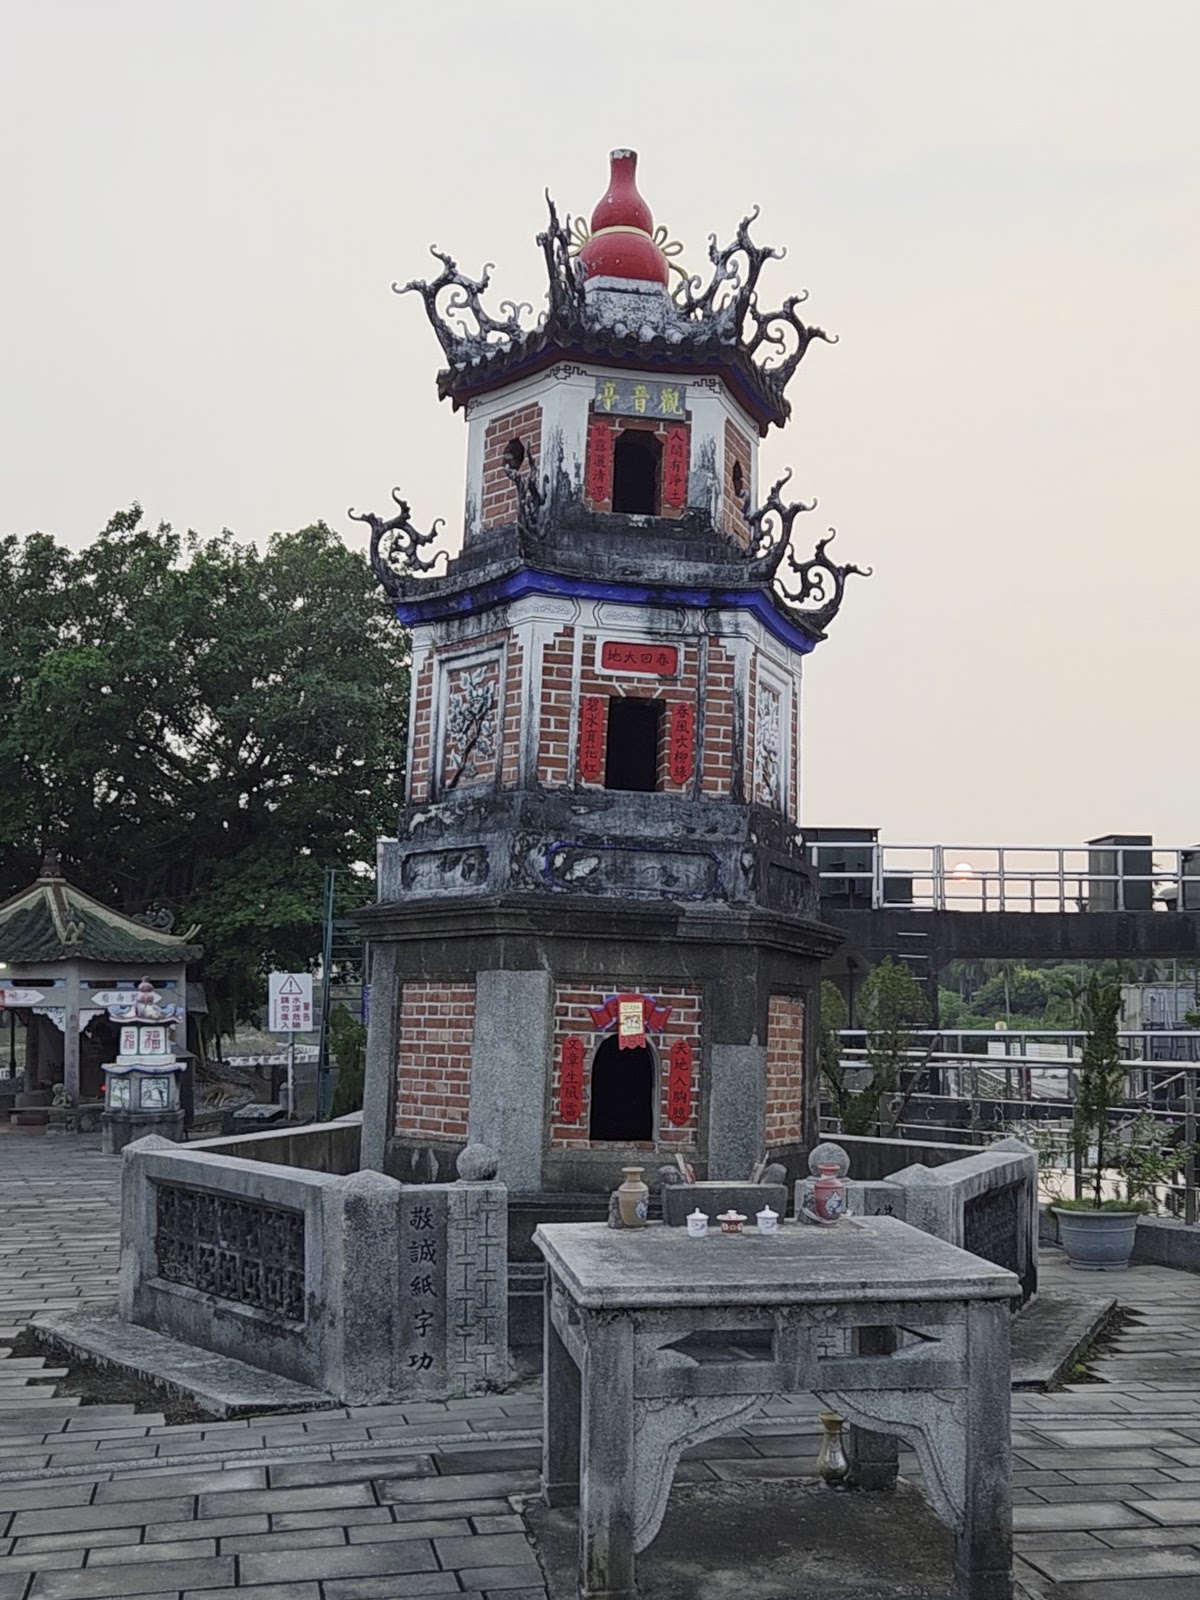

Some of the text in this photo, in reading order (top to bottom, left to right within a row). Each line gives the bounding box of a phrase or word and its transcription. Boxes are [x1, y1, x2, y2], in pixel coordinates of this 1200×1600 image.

[596, 382, 684, 415] 觀音亭
[669, 430, 684, 500] 人間有淨土
[606, 649, 670, 666] 春回大地
[673, 704, 690, 778] 春風吹柳綠
[292, 997, 301, 1029] 水深危險
[303, 1002, 310, 1021] 警告
[144, 1030, 161, 1049] 福
[565, 1039, 580, 1116] 文章生風雷
[671, 1042, 689, 1120] 天地入胸臆
[407, 1206, 438, 1371] 敬誠紙字功
